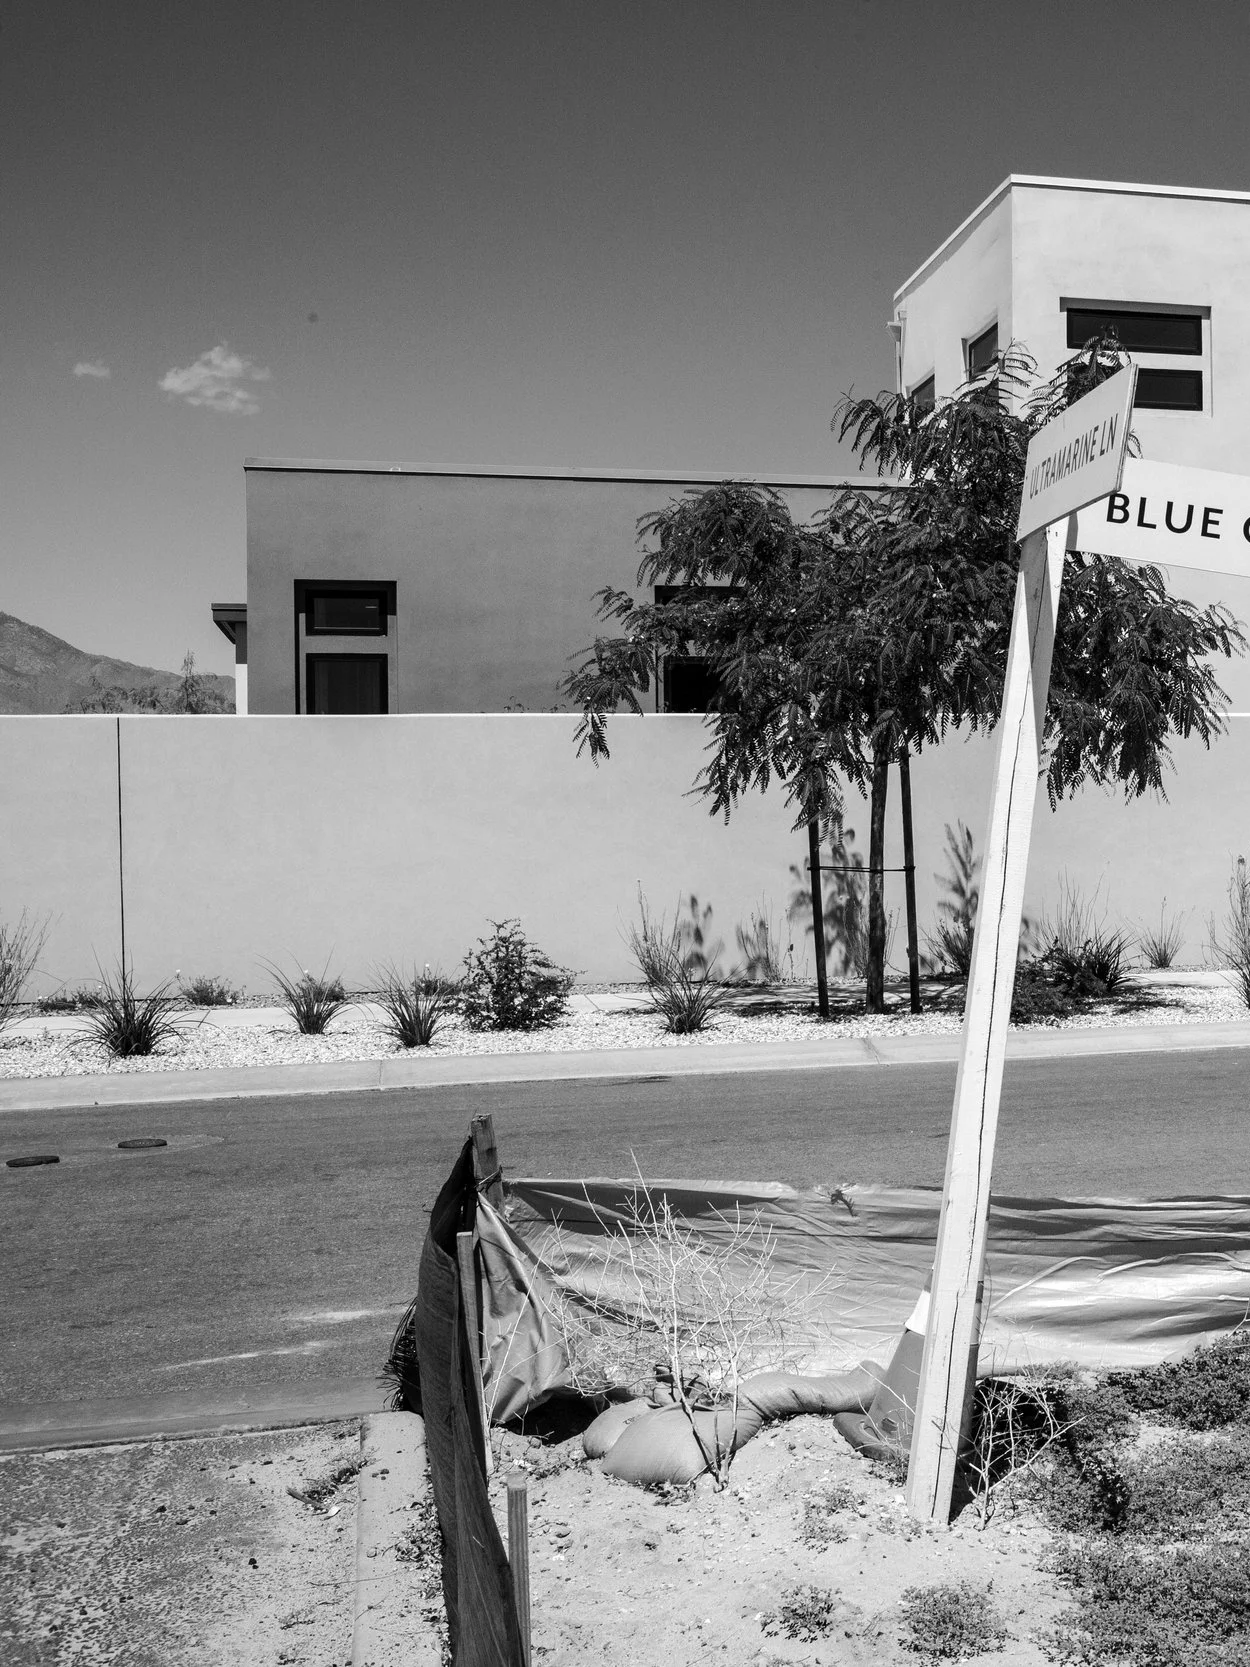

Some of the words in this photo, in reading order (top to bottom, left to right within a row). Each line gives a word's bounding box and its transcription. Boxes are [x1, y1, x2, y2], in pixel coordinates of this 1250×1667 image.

[1030, 425, 1099, 499] ULTRAMARINE
[1099, 413, 1118, 456] LN
[1106, 493, 1223, 539] BLUE
